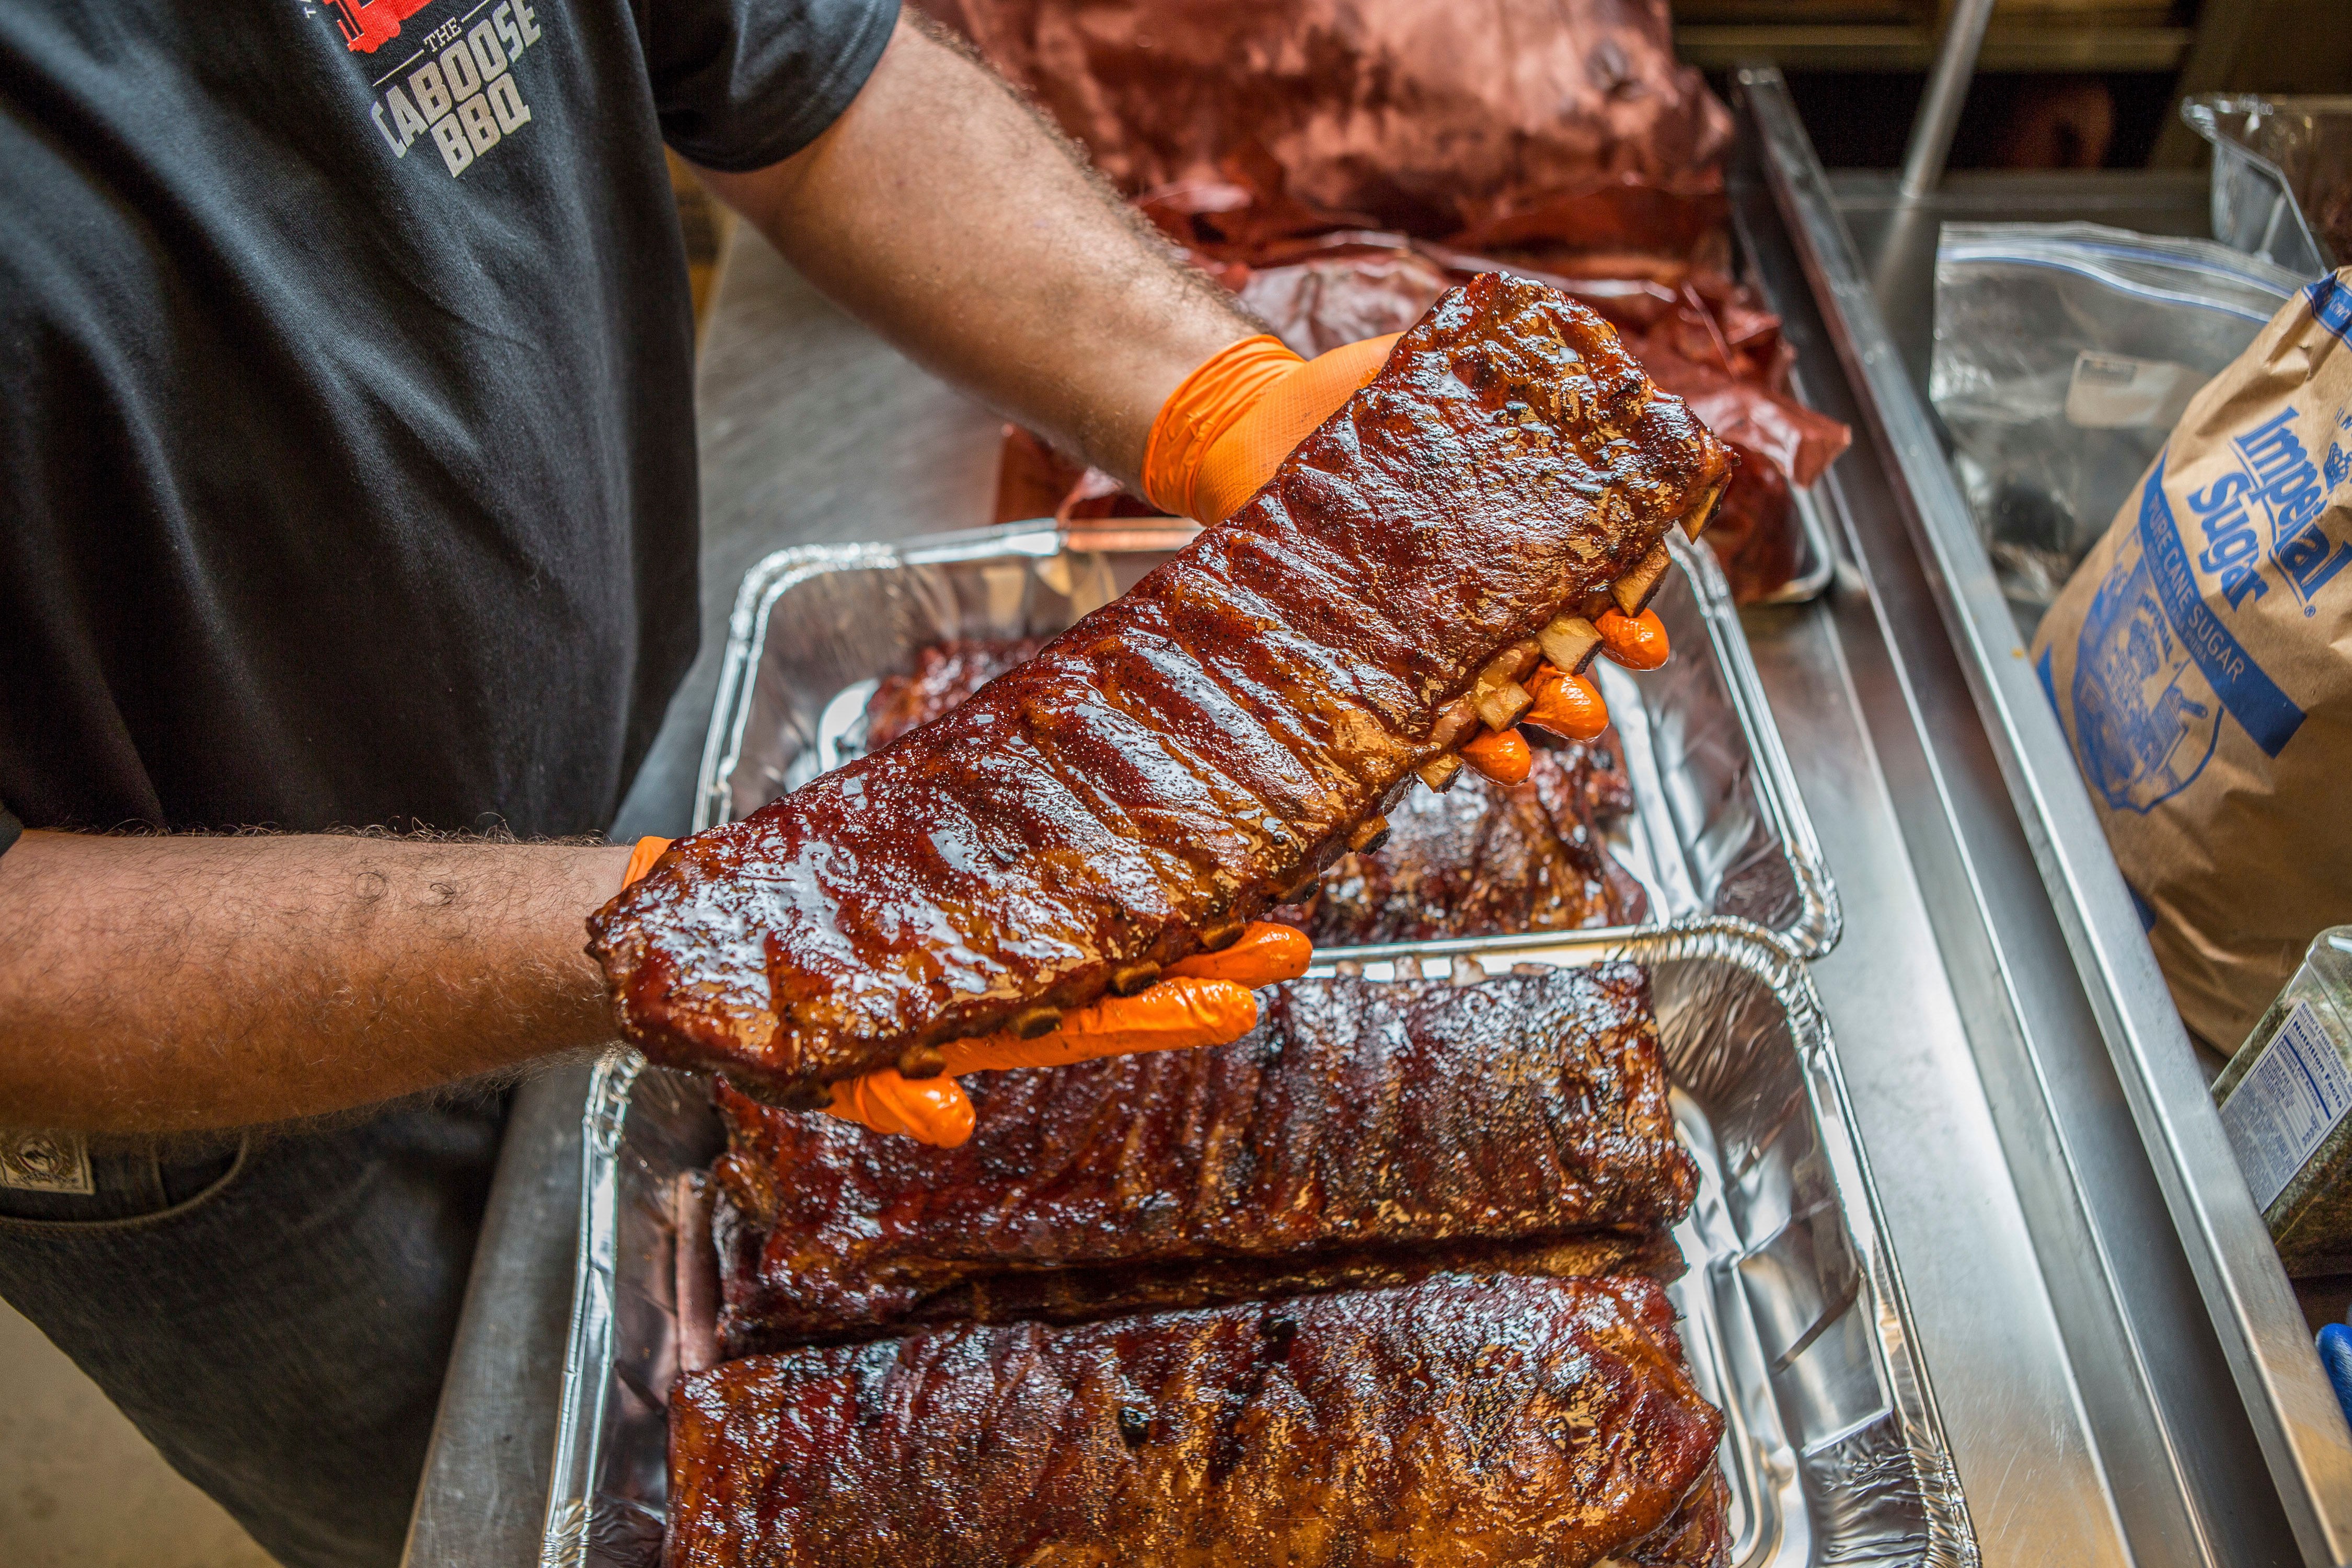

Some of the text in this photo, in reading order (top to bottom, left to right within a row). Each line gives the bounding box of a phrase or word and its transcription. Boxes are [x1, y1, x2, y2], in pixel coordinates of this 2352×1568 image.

[371, 0, 541, 158] CABOOSE
[423, 17, 463, 53] THE
[430, 73, 532, 178] BBQ
[2186, 473, 2269, 614] Sugar
[2233, 405, 2352, 603] Imperial
[2148, 492, 2173, 555] PURE
[2164, 547, 2194, 611] CANE
[2187, 603, 2245, 683] SUGAR
[2292, 1019, 2344, 1108] Nutrition Facts
